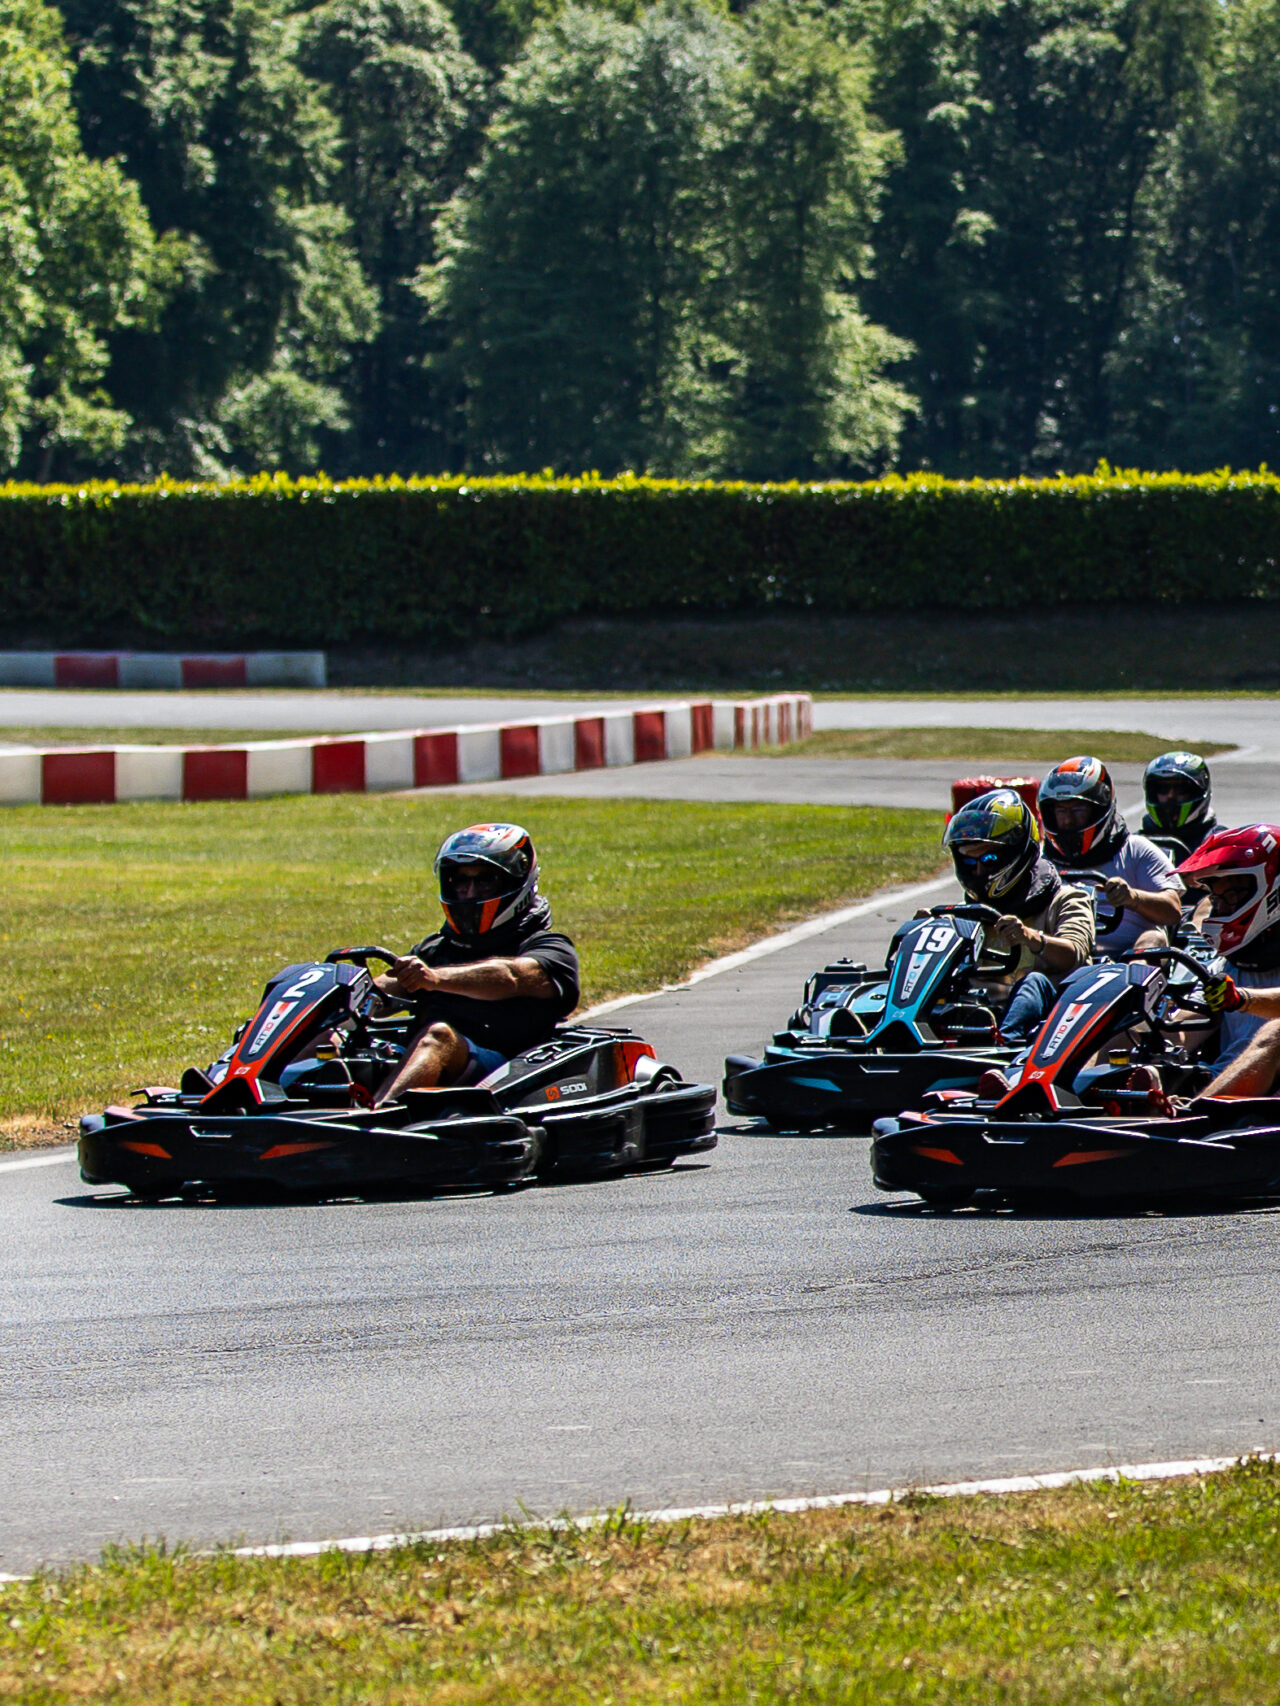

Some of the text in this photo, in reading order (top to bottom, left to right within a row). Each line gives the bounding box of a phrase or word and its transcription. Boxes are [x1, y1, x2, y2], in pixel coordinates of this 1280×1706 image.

[913, 926, 956, 953] 19
[281, 970, 324, 998] 2
[1075, 972, 1121, 1001] 1
[1048, 1024, 1068, 1050] RT10
[559, 1082, 588, 1096] SODI
